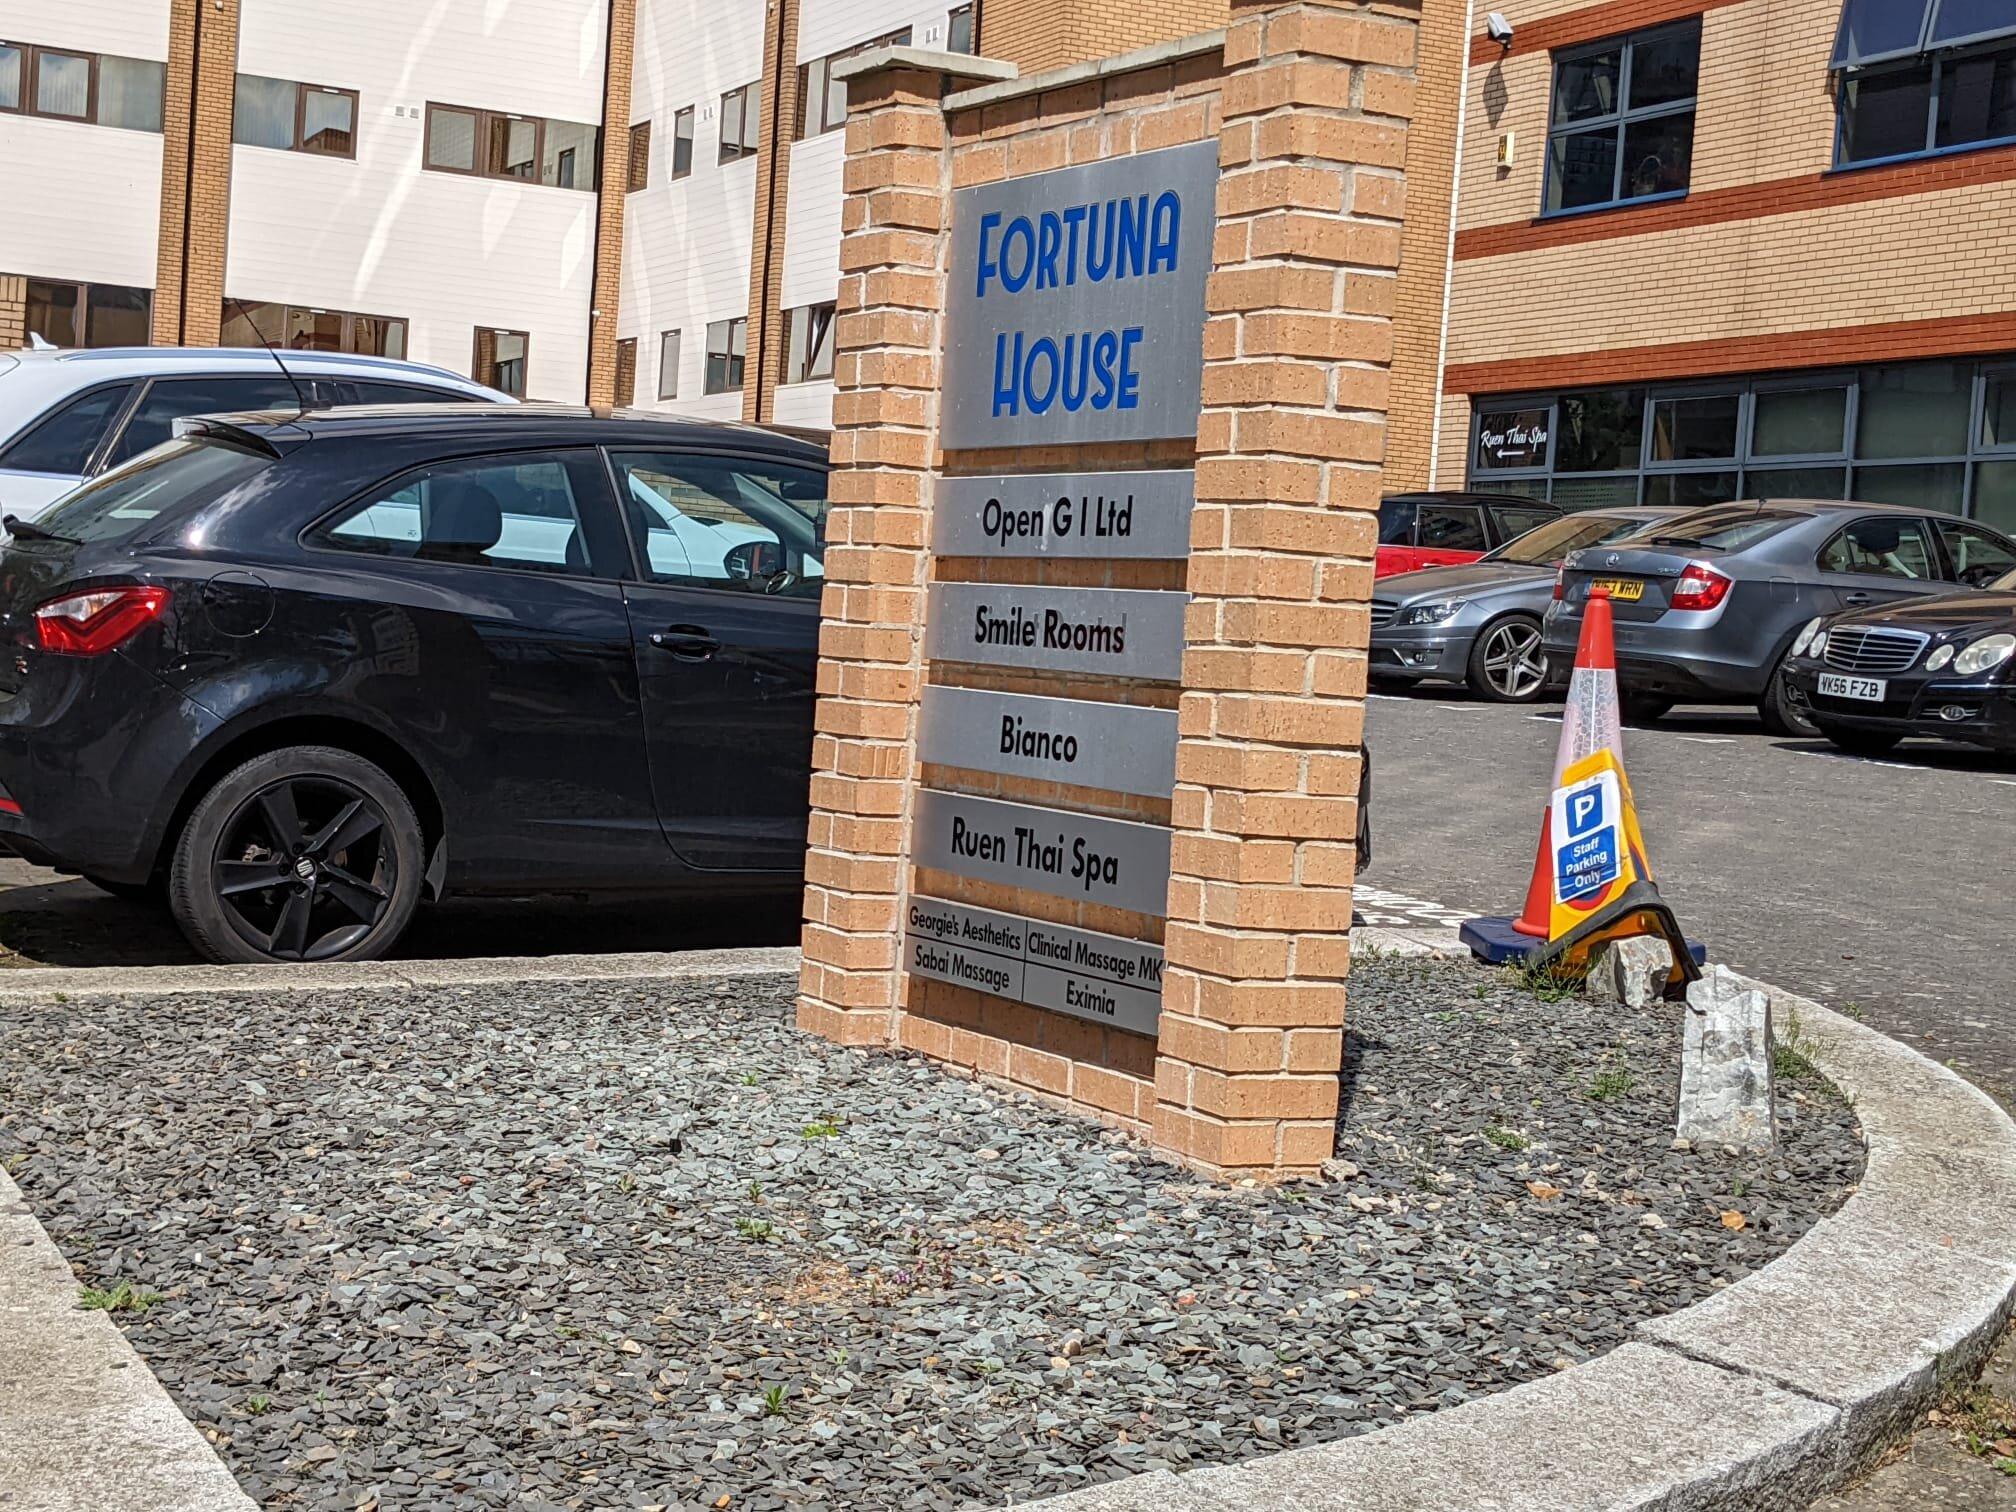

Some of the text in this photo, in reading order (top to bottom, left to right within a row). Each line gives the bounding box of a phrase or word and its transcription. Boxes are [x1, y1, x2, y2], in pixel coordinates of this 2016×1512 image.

[976, 189, 1181, 298] FORTUNA
[992, 326, 1144, 417] HOUSE
[1481, 424, 1547, 453] Ruen Thai Spa
[982, 498, 1044, 547] Open
[1095, 495, 1133, 537] Ltd
[1618, 581, 1642, 597] WRN
[975, 605, 1124, 653] Smile Rooms
[1850, 680, 1879, 698] FZB
[1000, 715, 1078, 763] Bianco
[1574, 794, 1595, 829] P
[951, 816, 1118, 891] Ruen Thai Spa
[1566, 851, 1607, 876] Parking
[1573, 836, 1599, 857] Staff
[1574, 870, 1600, 888] Only
[910, 906, 1021, 950] Georgie's Aesthetics
[914, 945, 1010, 992] Sabai Massage
[1028, 932, 1162, 983] Clinical Massage MK
[1066, 980, 1115, 1016] Eximia
